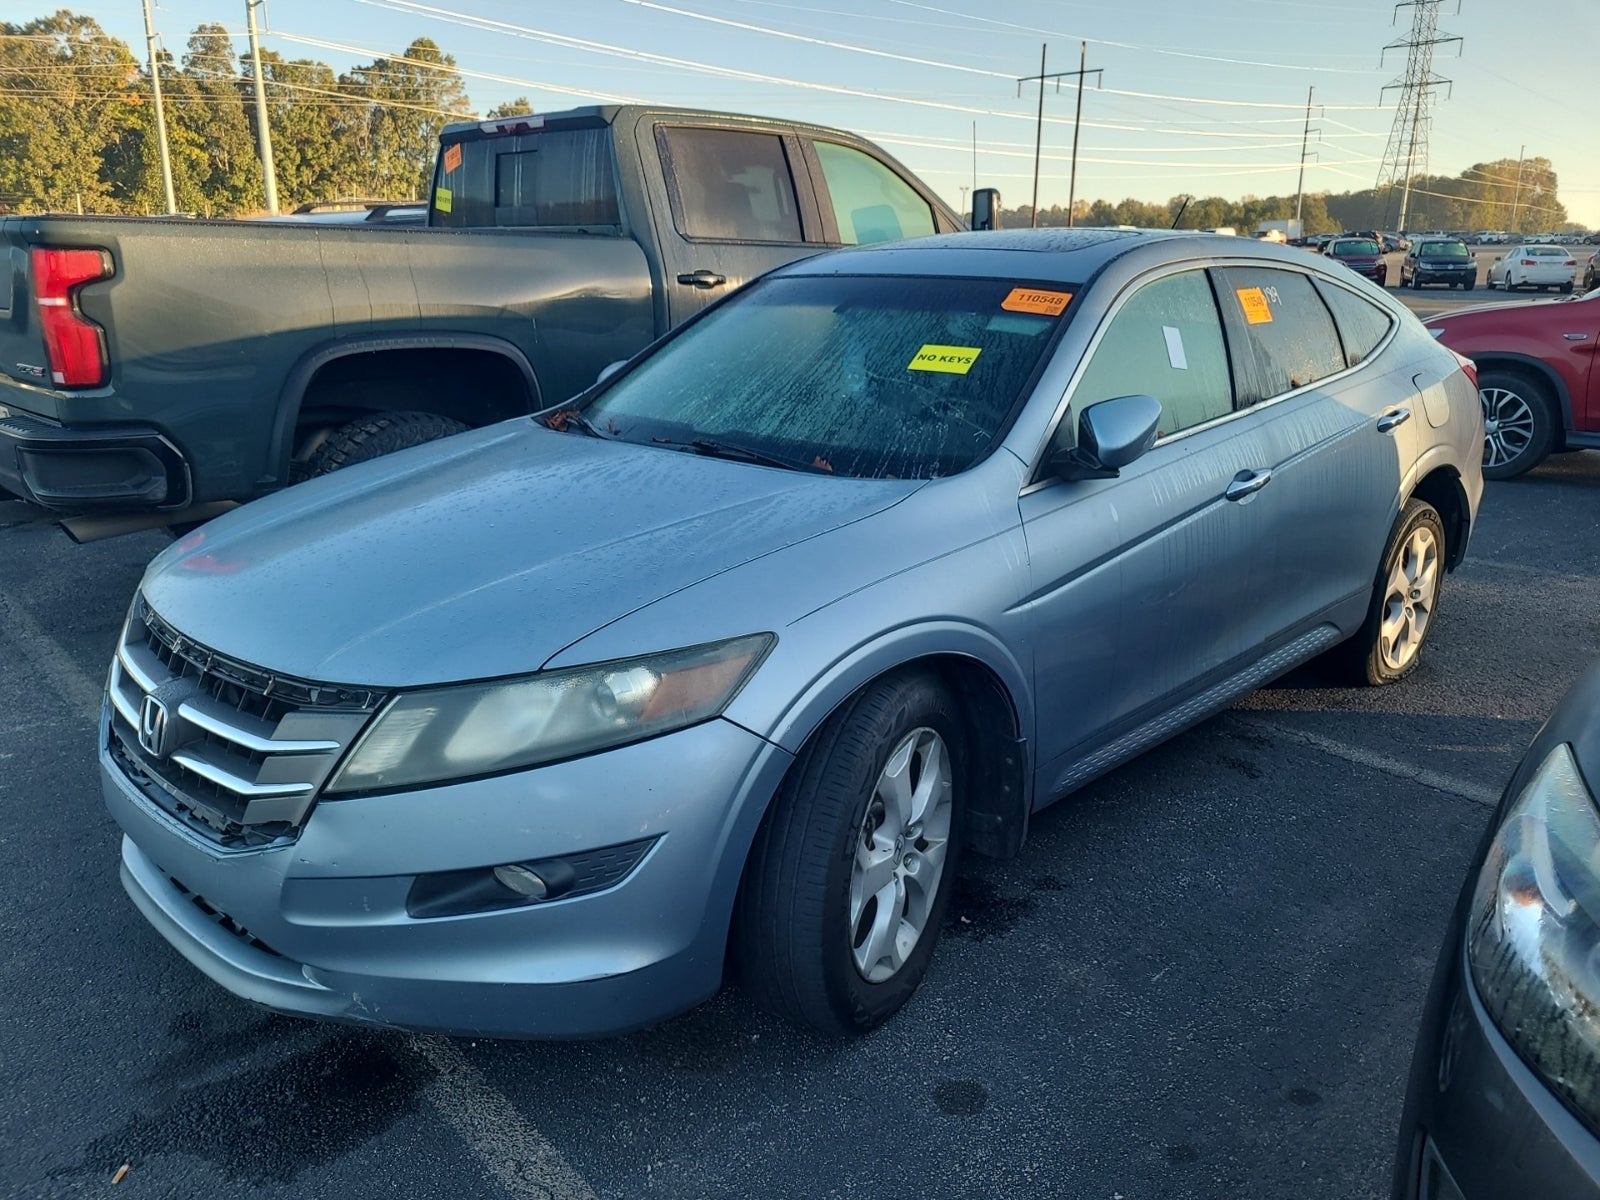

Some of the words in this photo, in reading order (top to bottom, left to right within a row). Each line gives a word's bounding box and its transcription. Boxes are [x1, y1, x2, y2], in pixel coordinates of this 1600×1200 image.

[1019, 294, 1064, 305] 110548
[917, 354, 937, 362] NO
[939, 355, 973, 365] KEYS
